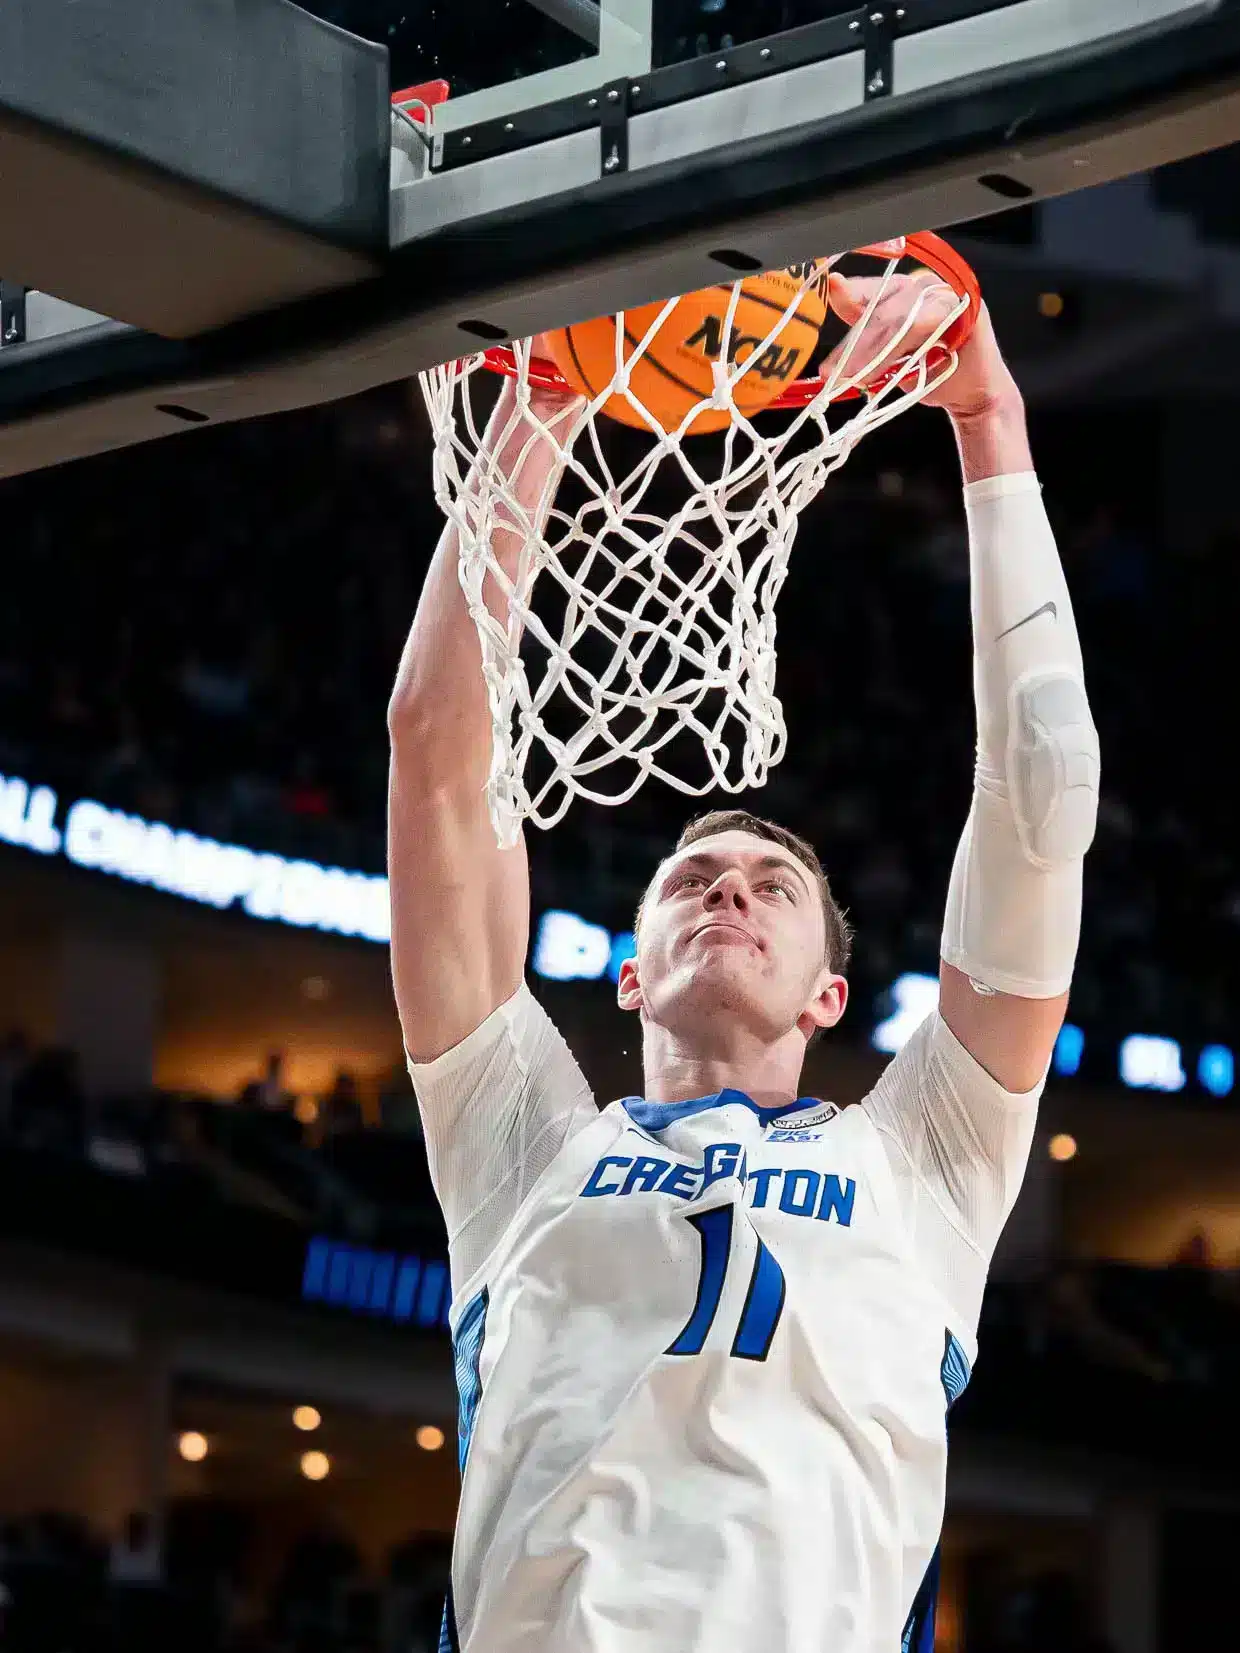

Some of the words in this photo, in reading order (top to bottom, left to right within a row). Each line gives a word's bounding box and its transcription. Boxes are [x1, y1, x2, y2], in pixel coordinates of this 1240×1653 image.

[684, 314, 801, 381] NCAA
[579, 1143, 856, 1227] CREGTON
[662, 1202, 786, 1361] 11
